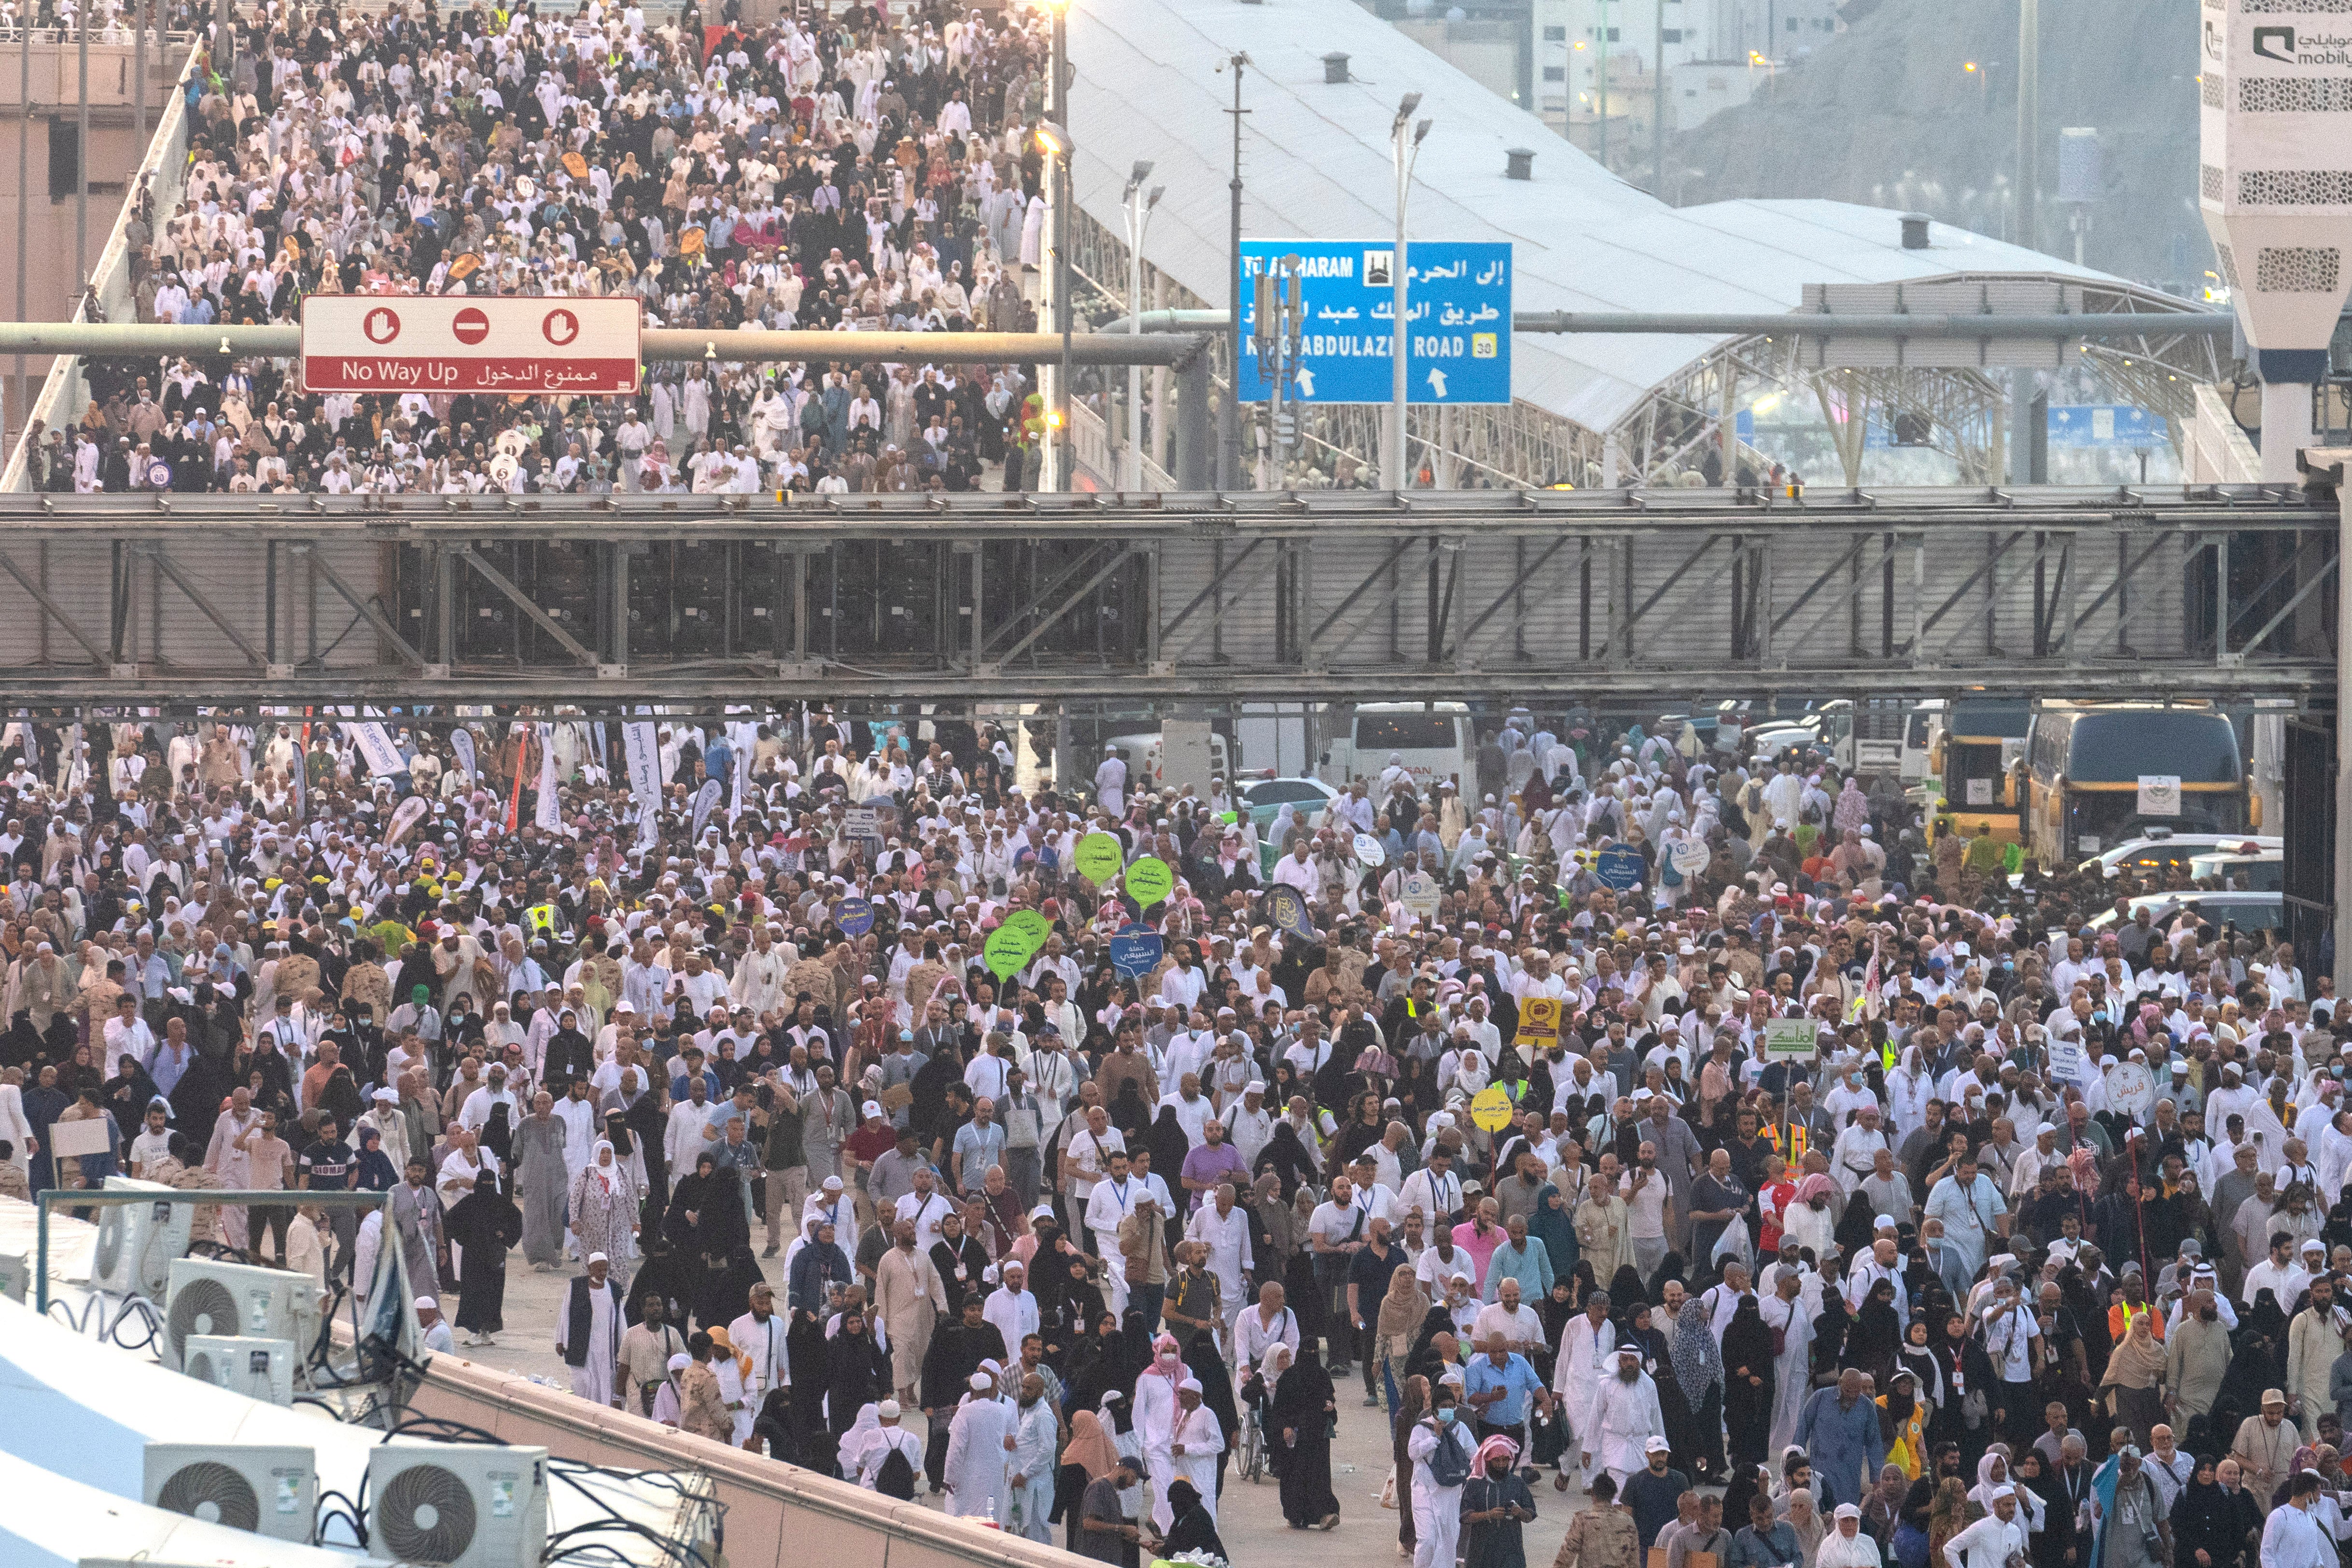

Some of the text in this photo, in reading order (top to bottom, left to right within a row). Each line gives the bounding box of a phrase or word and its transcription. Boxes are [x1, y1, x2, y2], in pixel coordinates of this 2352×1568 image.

[1406, 260, 1503, 288] إلى الحرم
[1317, 304, 1359, 324] عبد
[1440, 302, 1499, 325] طريق
[1301, 335, 1395, 356] ABDULAZI
[1414, 336, 1464, 357] ROAD
[342, 362, 458, 383] No Way Up
[476, 364, 538, 386] الدخول
[545, 369, 597, 389] ممنوع
[154, 474, 165, 482] 80
[1120, 949, 1155, 962] السبيعي
[1769, 1025, 1815, 1043] المناسك
[2117, 1078, 2144, 1099] قريش
